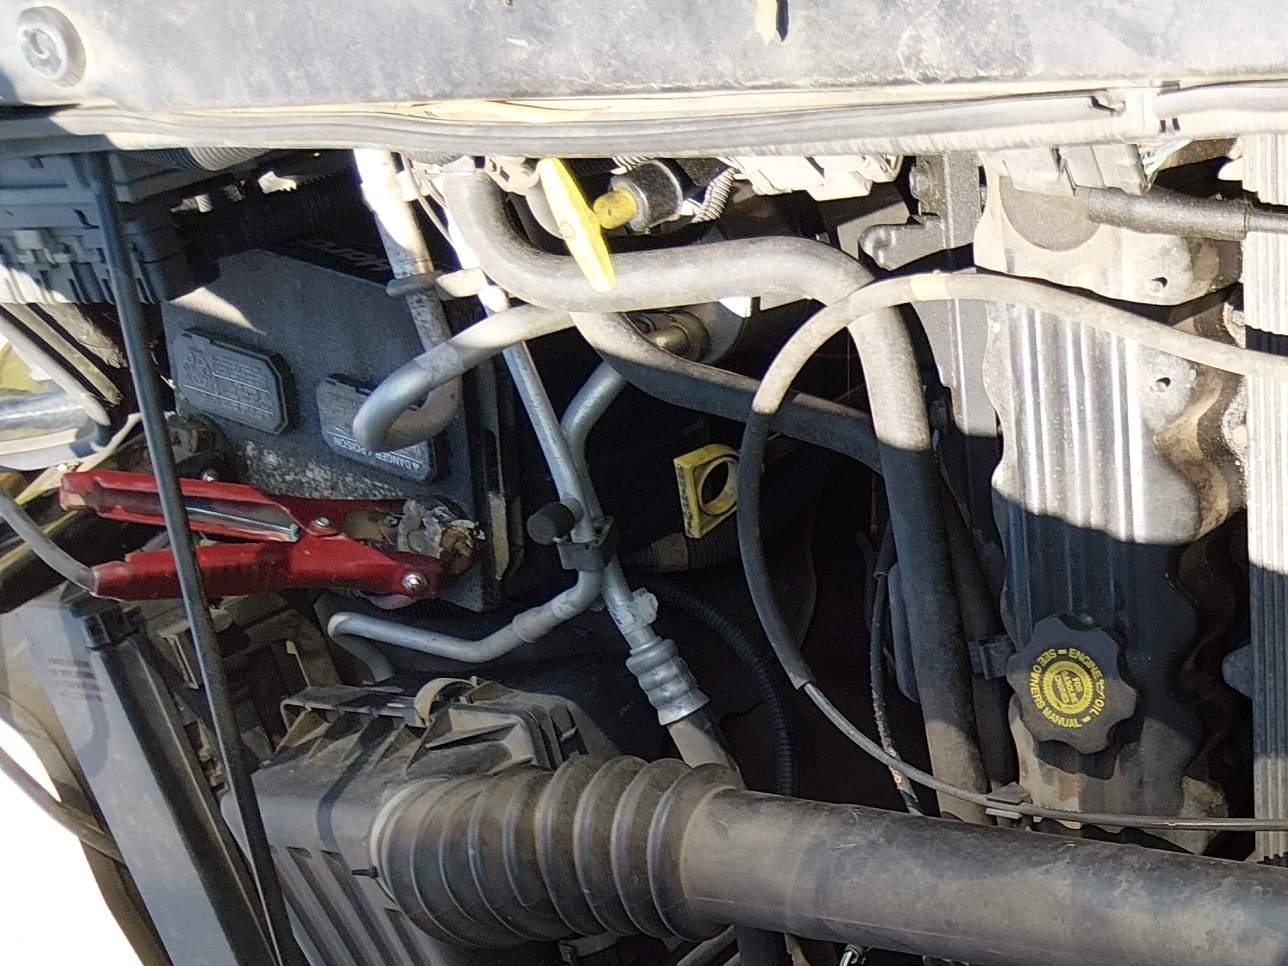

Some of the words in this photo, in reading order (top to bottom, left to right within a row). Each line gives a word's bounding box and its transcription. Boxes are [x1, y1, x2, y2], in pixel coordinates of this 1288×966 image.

[376, 452, 411, 470] DANGER
[1037, 649, 1057, 667] SEE
[1029, 665, 1046, 709] OWNERS
[1068, 648, 1103, 680] ENGINE
[1089, 700, 1105, 716] OIL
[1042, 709, 1083, 728] MANUAL
